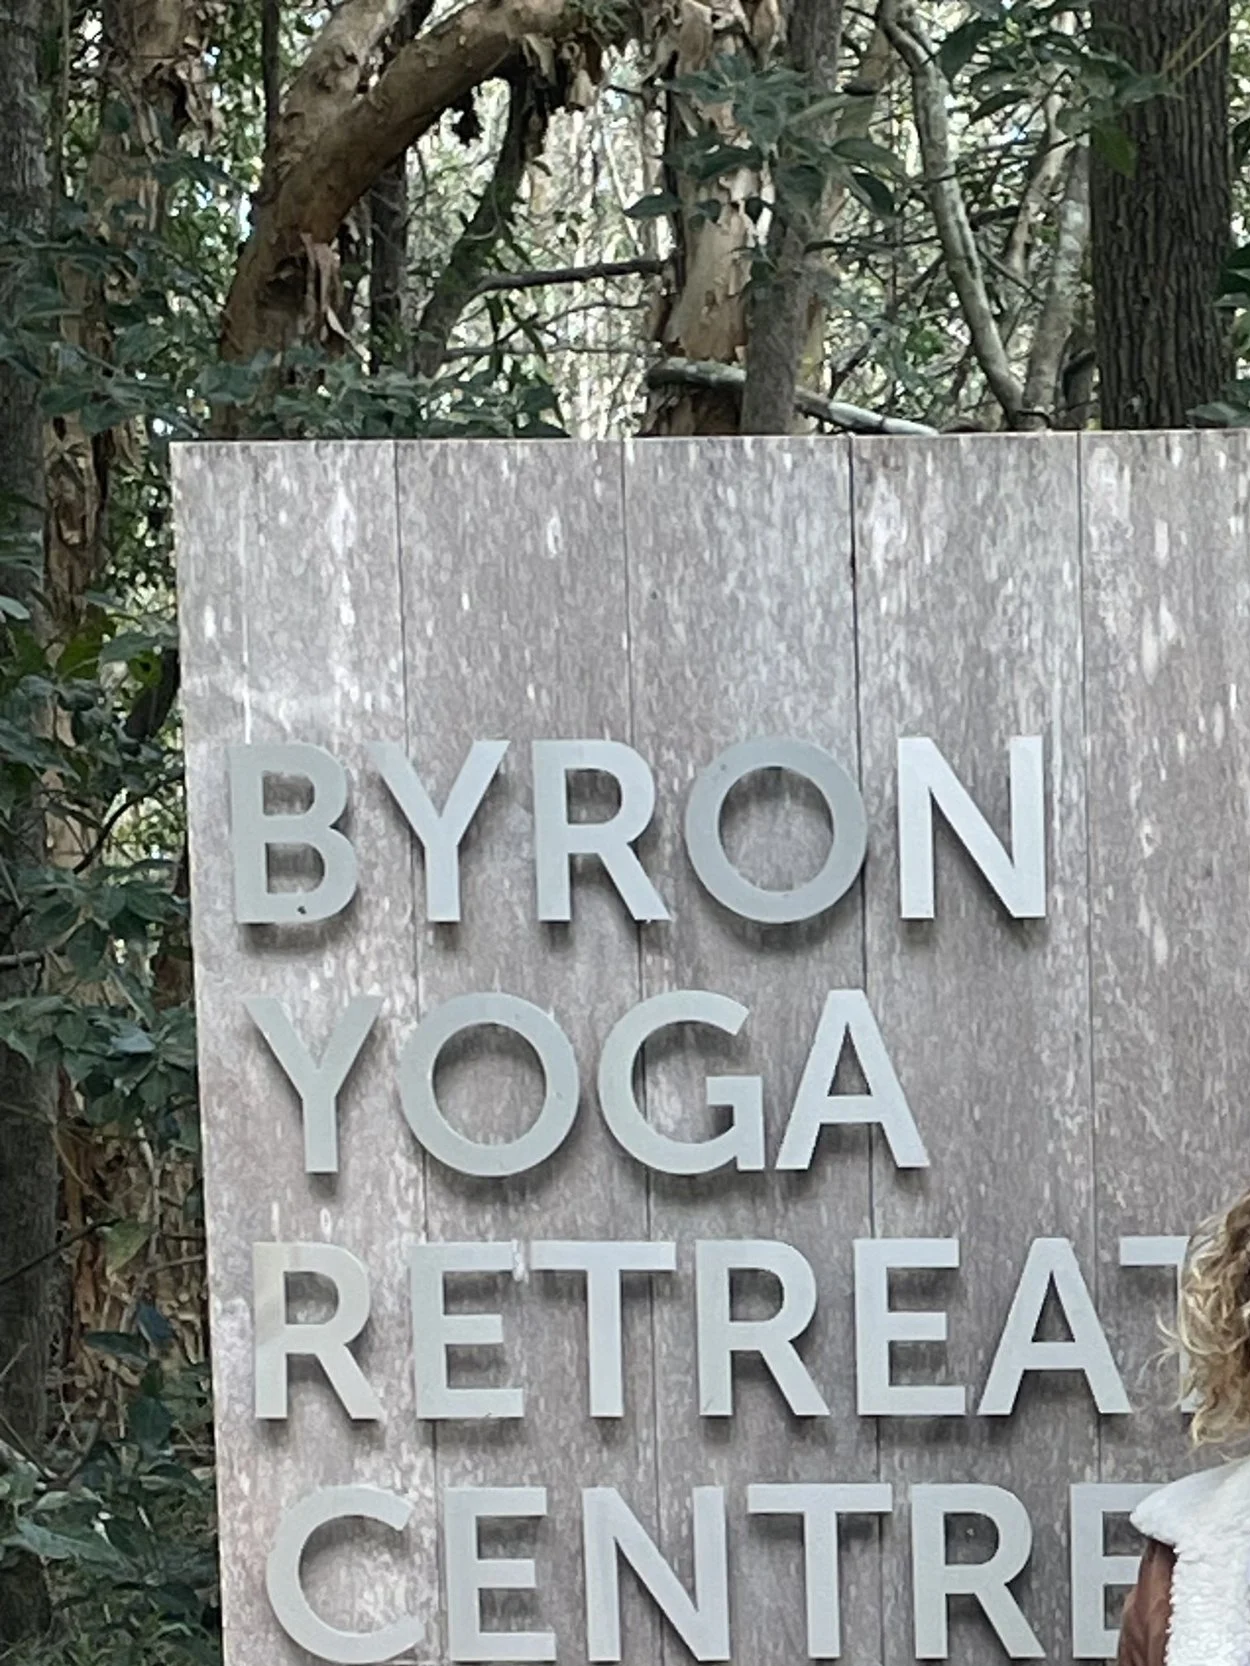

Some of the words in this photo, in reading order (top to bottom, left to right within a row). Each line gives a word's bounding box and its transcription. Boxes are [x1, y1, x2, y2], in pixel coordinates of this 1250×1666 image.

[226, 735, 1047, 926] BYRON
[245, 988, 931, 1177] YOGA
[265, 1482, 1172, 1666] CENTRE
